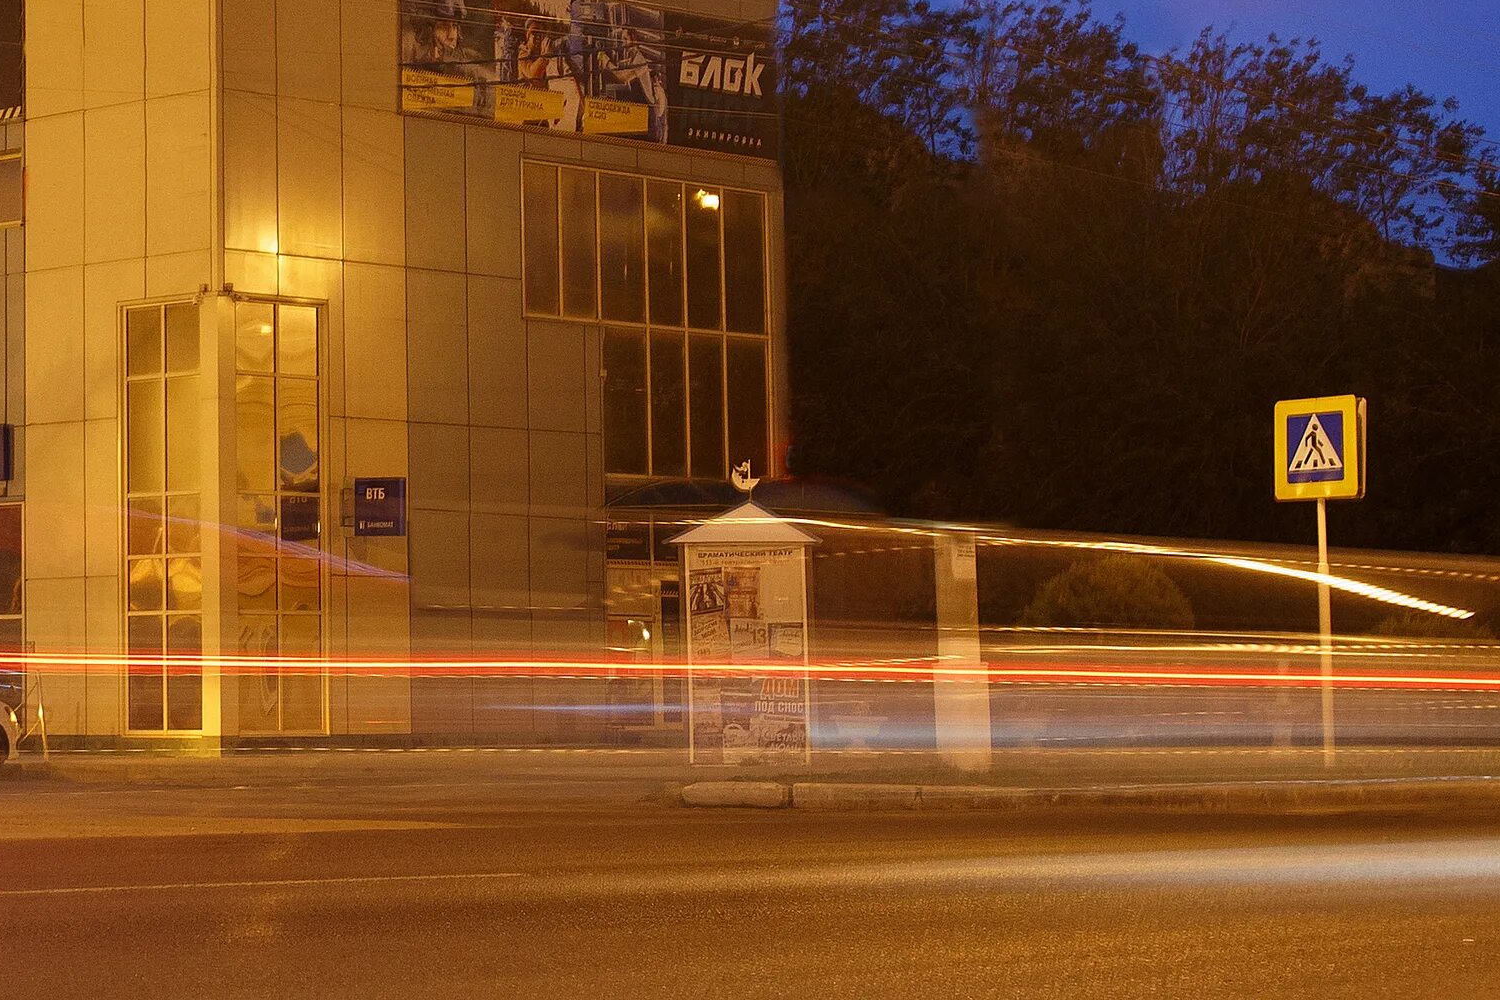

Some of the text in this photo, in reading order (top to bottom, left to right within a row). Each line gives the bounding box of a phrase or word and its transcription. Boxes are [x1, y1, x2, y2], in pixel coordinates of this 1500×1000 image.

[679, 50, 766, 97] БЛОК
[687, 127, 763, 147] ЭКИПИРОВКА
[366, 487, 385, 500] ВТБ
[697, 551, 767, 559] ДРАМАТИЧЕСКИЙ
[754, 701, 804, 714] ПОД СНОС
